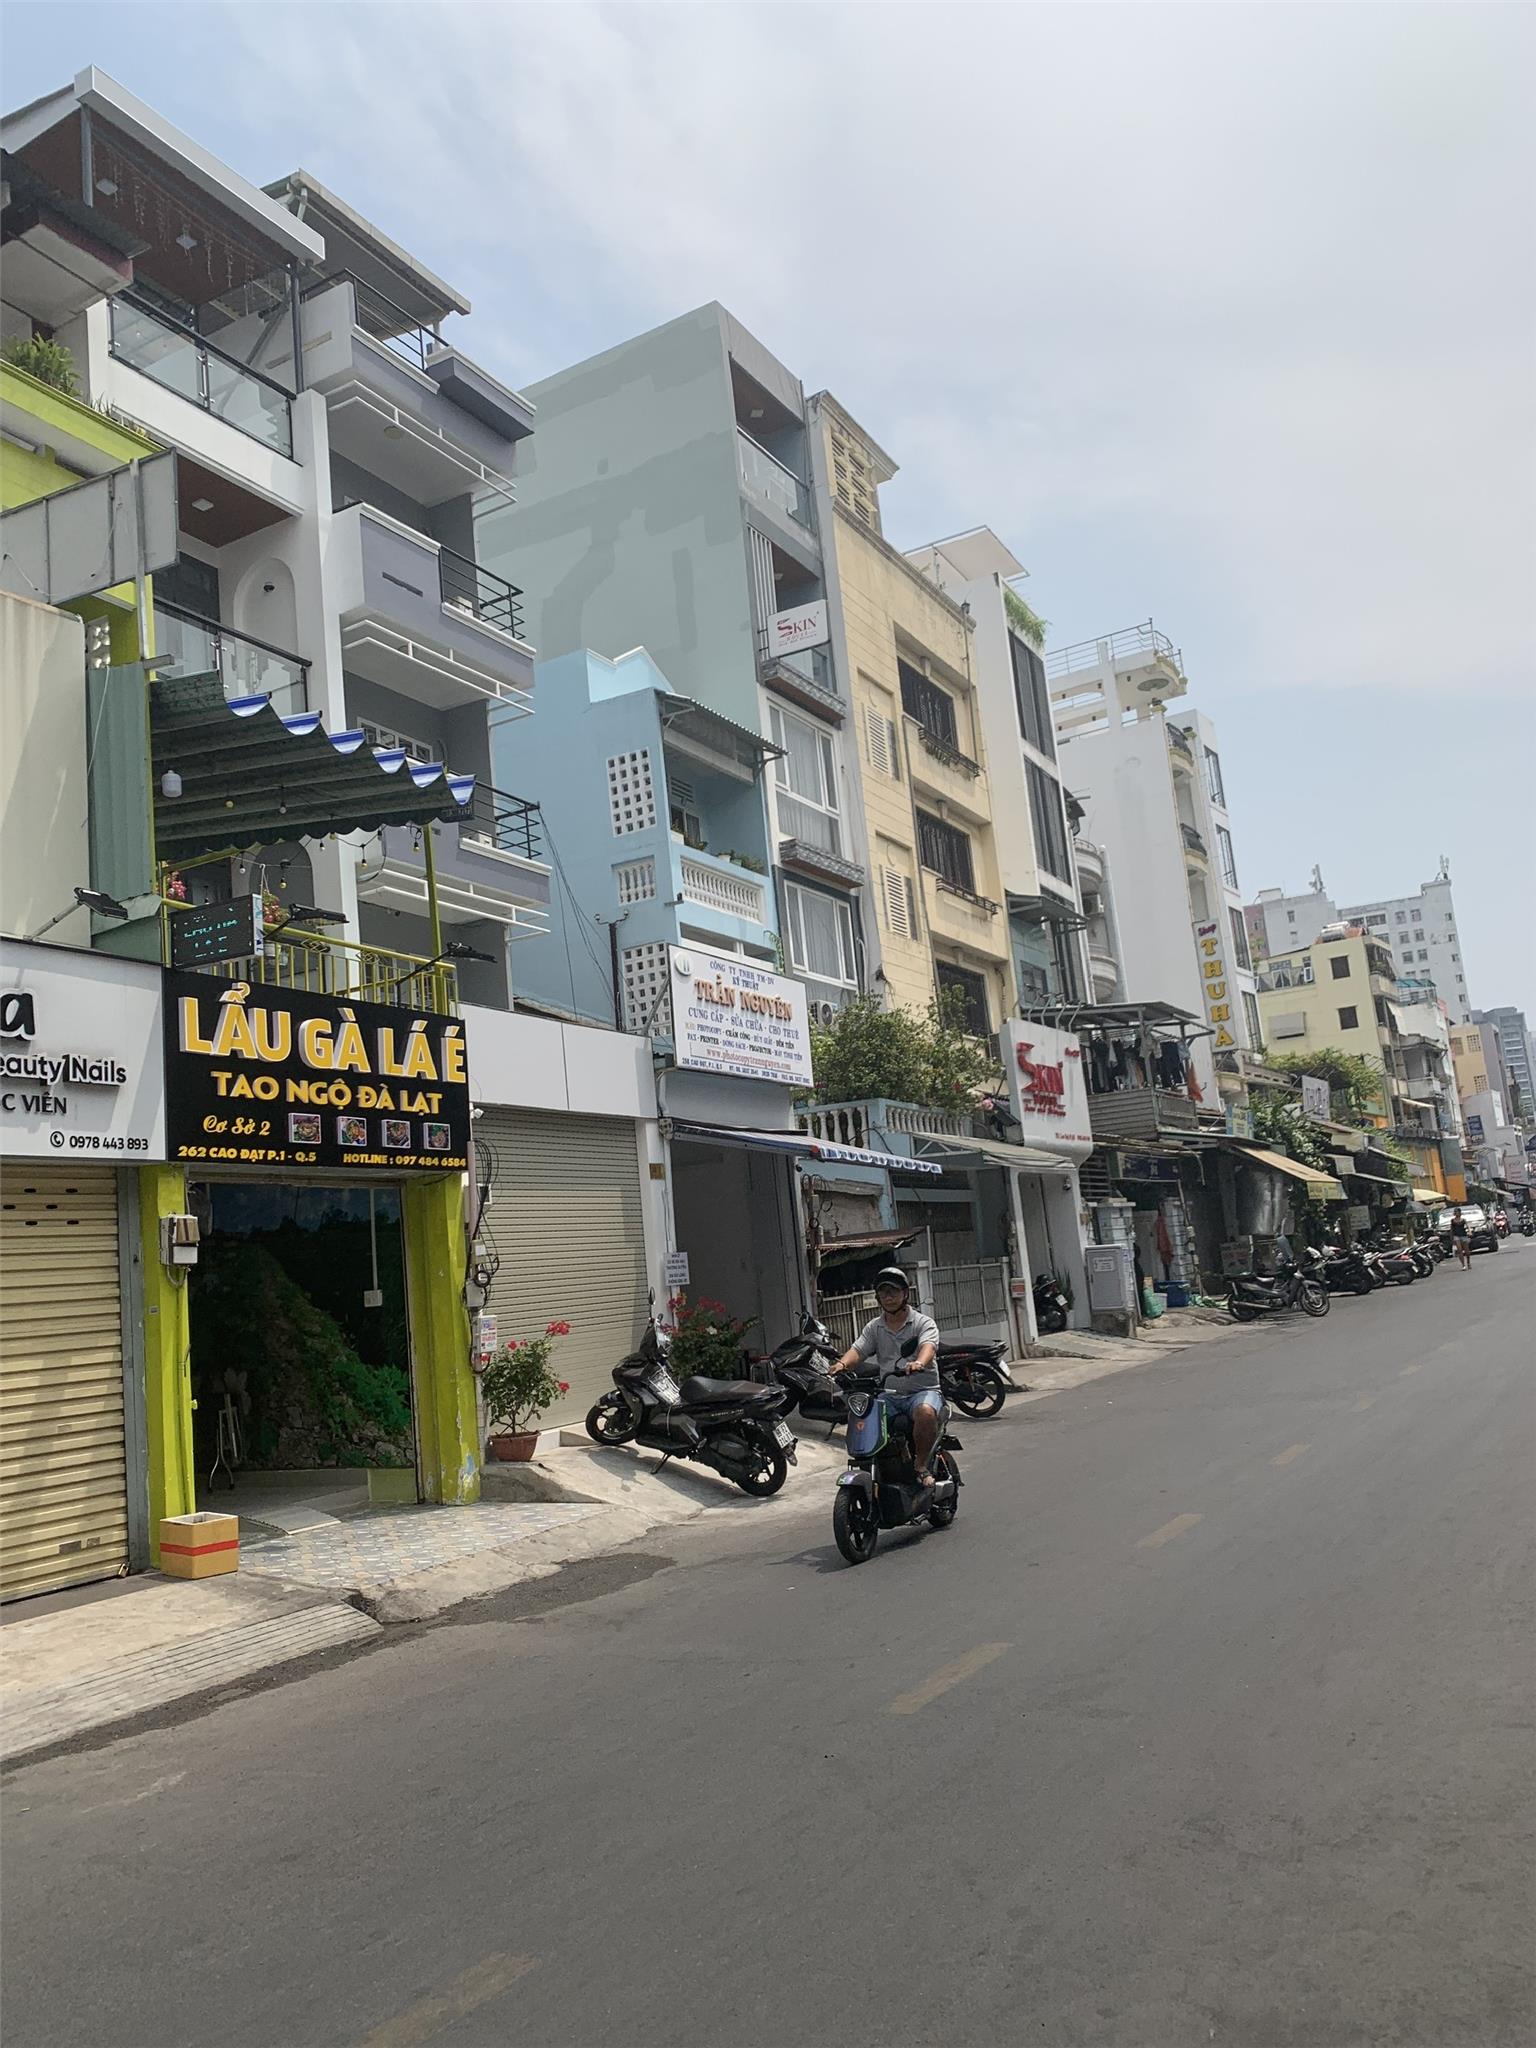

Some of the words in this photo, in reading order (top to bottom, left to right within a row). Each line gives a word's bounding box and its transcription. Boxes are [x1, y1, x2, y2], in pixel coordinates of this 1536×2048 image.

[777, 616, 817, 638] SKIN
[709, 960, 726, 972] CÔNG
[729, 966, 736, 975] TY
[739, 969, 755, 980] TNHH
[694, 973, 735, 1009] TRẦN
[178, 981, 291, 1062] LẨU
[298, 1007, 371, 1074] GÀ
[378, 1019, 438, 1081] LÁ
[440, 1025, 466, 1084] É
[688, 1007, 708, 1020] CUNG
[710, 1009, 724, 1023] CẤP
[731, 1013, 743, 1027] SỬA
[769, 1024, 782, 1036] CHO
[783, 1028, 799, 1040] THUÊ
[700, 1035, 719, 1045] PRINTER
[72, 1056, 127, 1083] Nails
[0, 1093, 16, 1111] C
[21, 1091, 67, 1114] VIÊN
[210, 1071, 280, 1100] TAO
[286, 1078, 352, 1110] NGỘ
[356, 1083, 395, 1110] ĐÀ
[400, 1090, 443, 1116] LẠT
[203, 1114, 228, 1133] Cơ
[231, 1117, 256, 1135] Sở
[259, 1121, 271, 1136] 2
[69, 1135, 100, 1148] 0978
[103, 1137, 124, 1150] 443
[127, 1138, 149, 1150] 893
[177, 1145, 207, 1157] 262
[209, 1147, 237, 1159] CAO
[240, 1149, 264, 1163] ĐẠT
[267, 1150, 285, 1161] P.1
[295, 1151, 317, 1162] Q.5
[343, 1153, 388, 1164] HOTLINE
[395, 1155, 417, 1165] 097
[418, 1156, 439, 1166] 484
[441, 1157, 467, 1167] 6584
